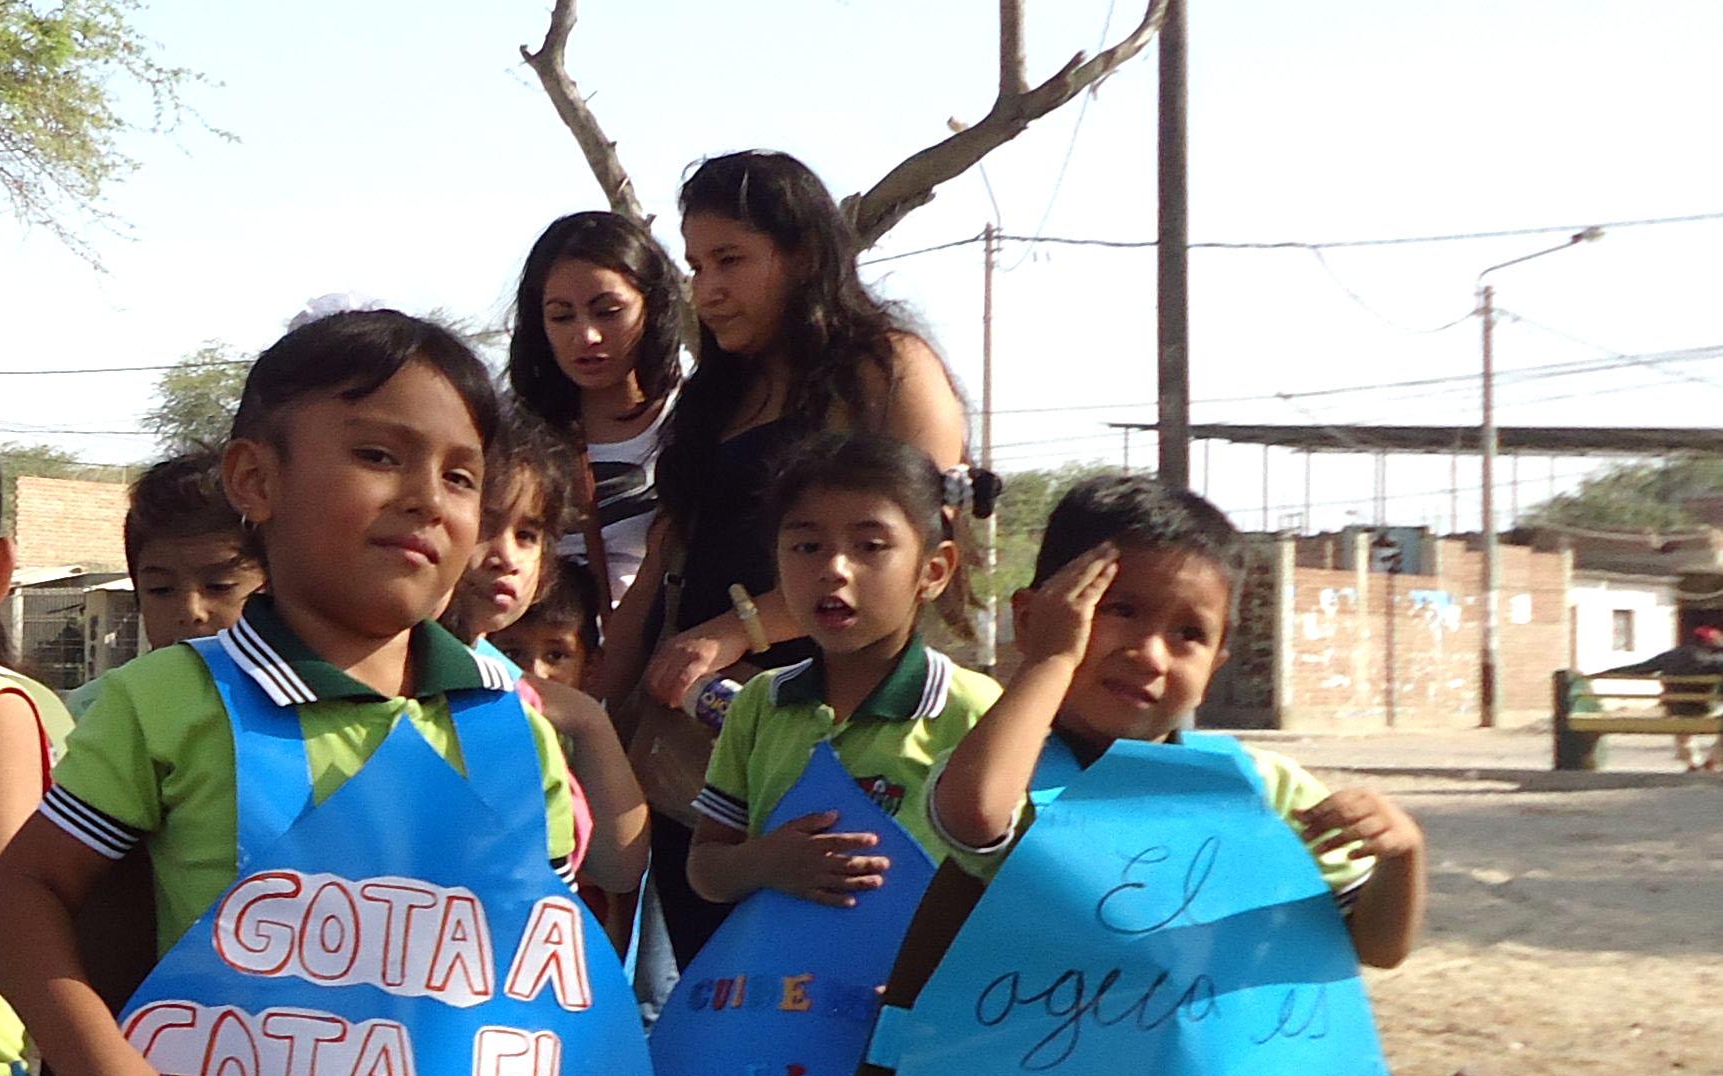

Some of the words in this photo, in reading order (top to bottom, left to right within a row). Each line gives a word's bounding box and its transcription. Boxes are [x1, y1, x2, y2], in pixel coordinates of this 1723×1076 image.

[213, 870, 493, 1007] GOTA
[504, 896, 591, 1012] A
[1095, 836, 1220, 936] El
